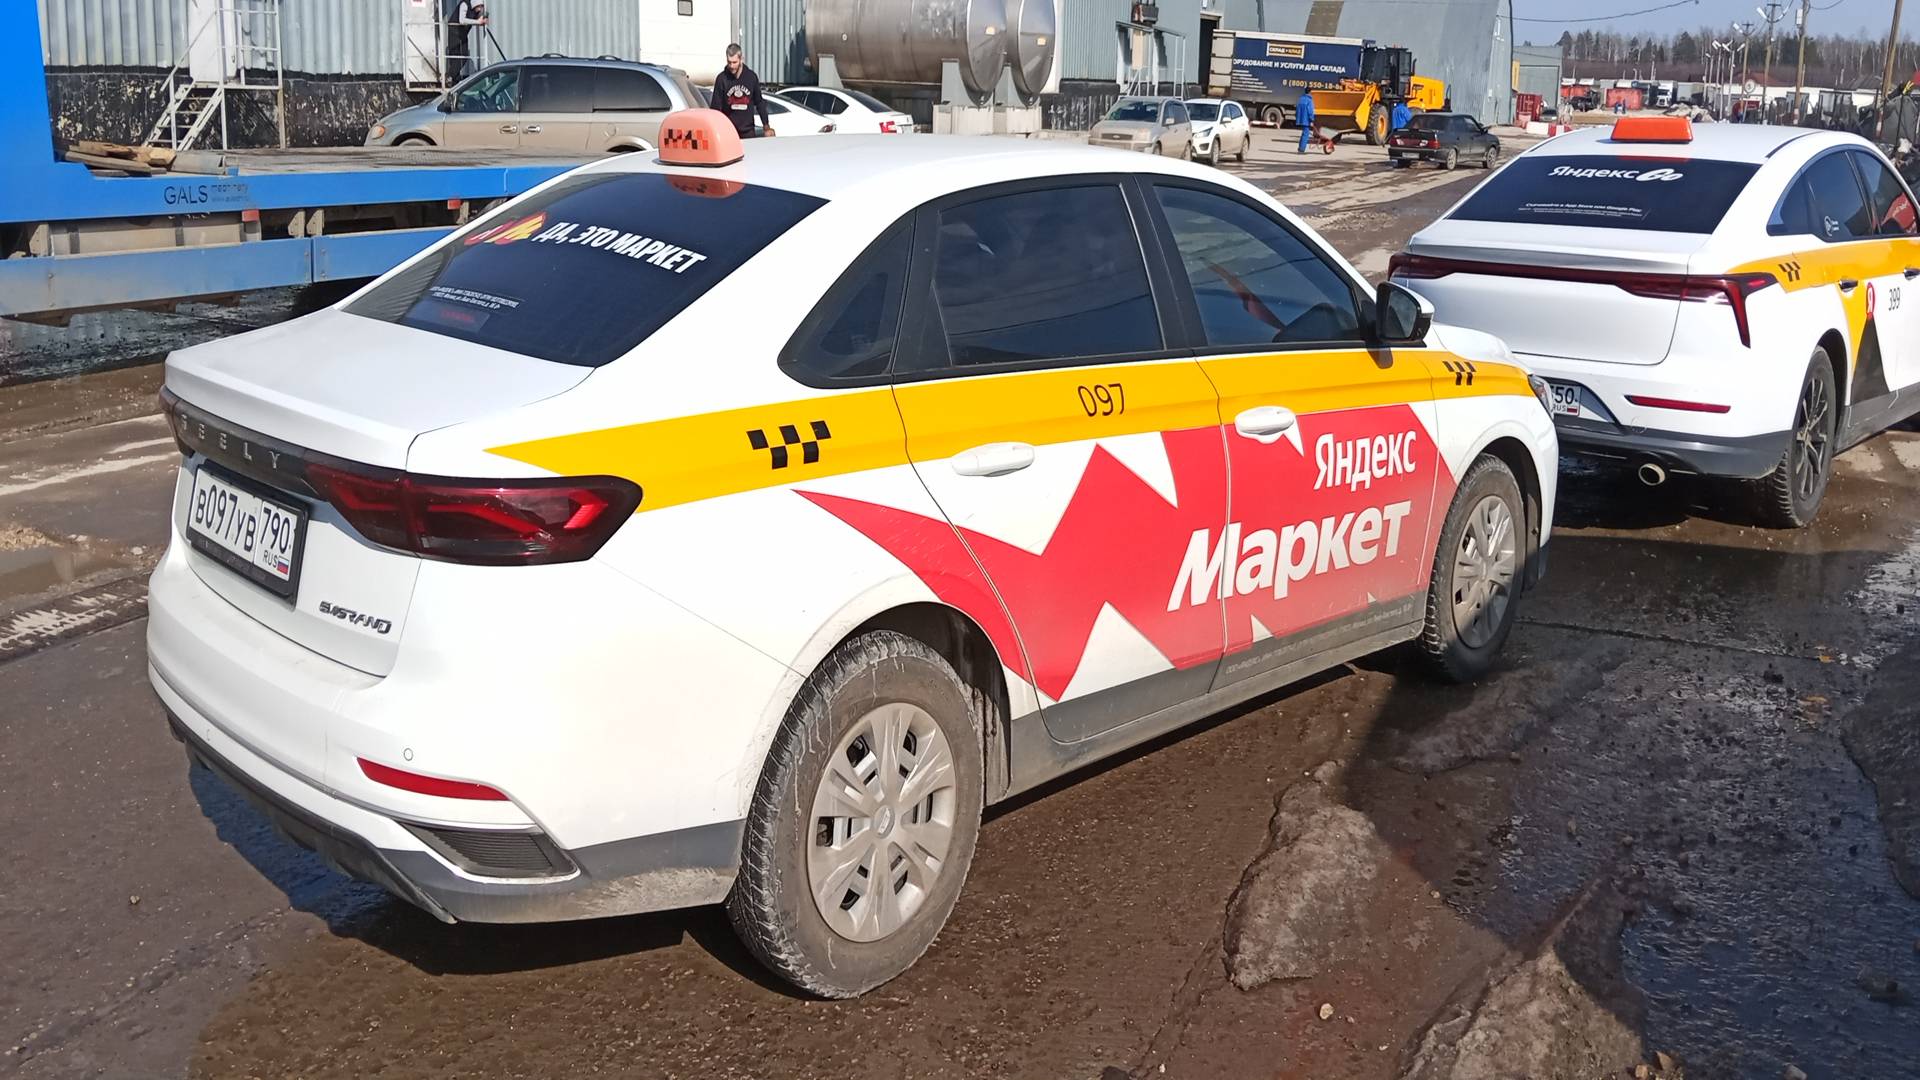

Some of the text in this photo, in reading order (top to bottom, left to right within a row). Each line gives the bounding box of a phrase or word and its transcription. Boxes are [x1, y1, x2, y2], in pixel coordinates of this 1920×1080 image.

[1280, 62, 1304, 71] УСЛУГИ
[1305, 63, 1319, 72] ДЛЯ
[1320, 65, 1346, 74] СКЛАДА
[1548, 165, 1639, 180] Яндекс
[163, 184, 209, 205] GALS
[531, 221, 580, 245] ДА,
[568, 225, 619, 248] ЭТО
[604, 232, 707, 274] МАРКЕТ
[1888, 286, 1901, 312] 399
[1077, 382, 1125, 418] 097
[1551, 385, 1575, 405] 50
[1313, 430, 1417, 492] Яндекс
[260, 506, 291, 554] 790
[262, 549, 279, 569] RUS
[1166, 499, 1412, 613] Маркет
